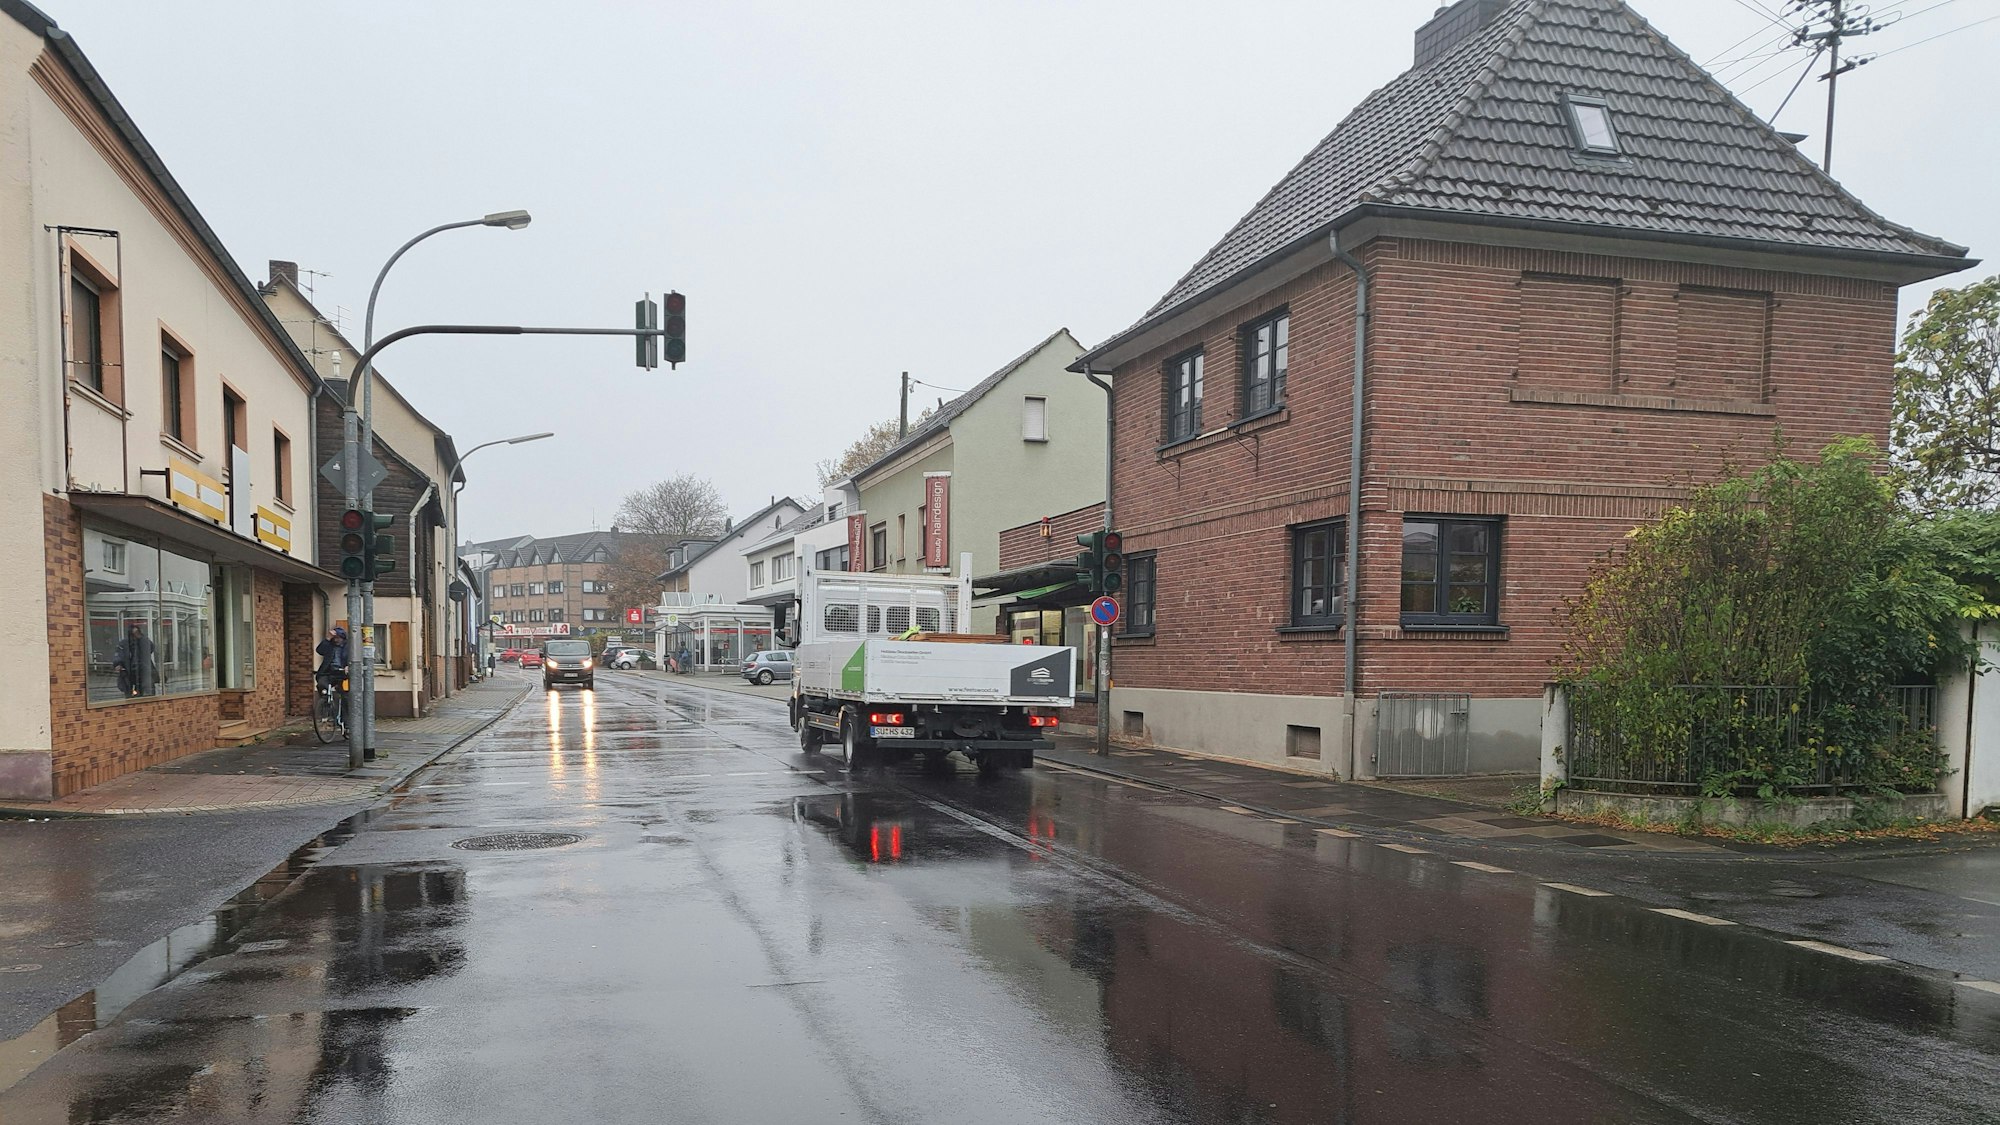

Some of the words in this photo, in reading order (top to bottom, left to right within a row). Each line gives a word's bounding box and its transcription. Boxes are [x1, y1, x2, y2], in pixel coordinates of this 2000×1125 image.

[932, 481, 944, 535] hairdesign
[934, 538, 943, 562] beauty
[889, 728, 899, 736] HS
